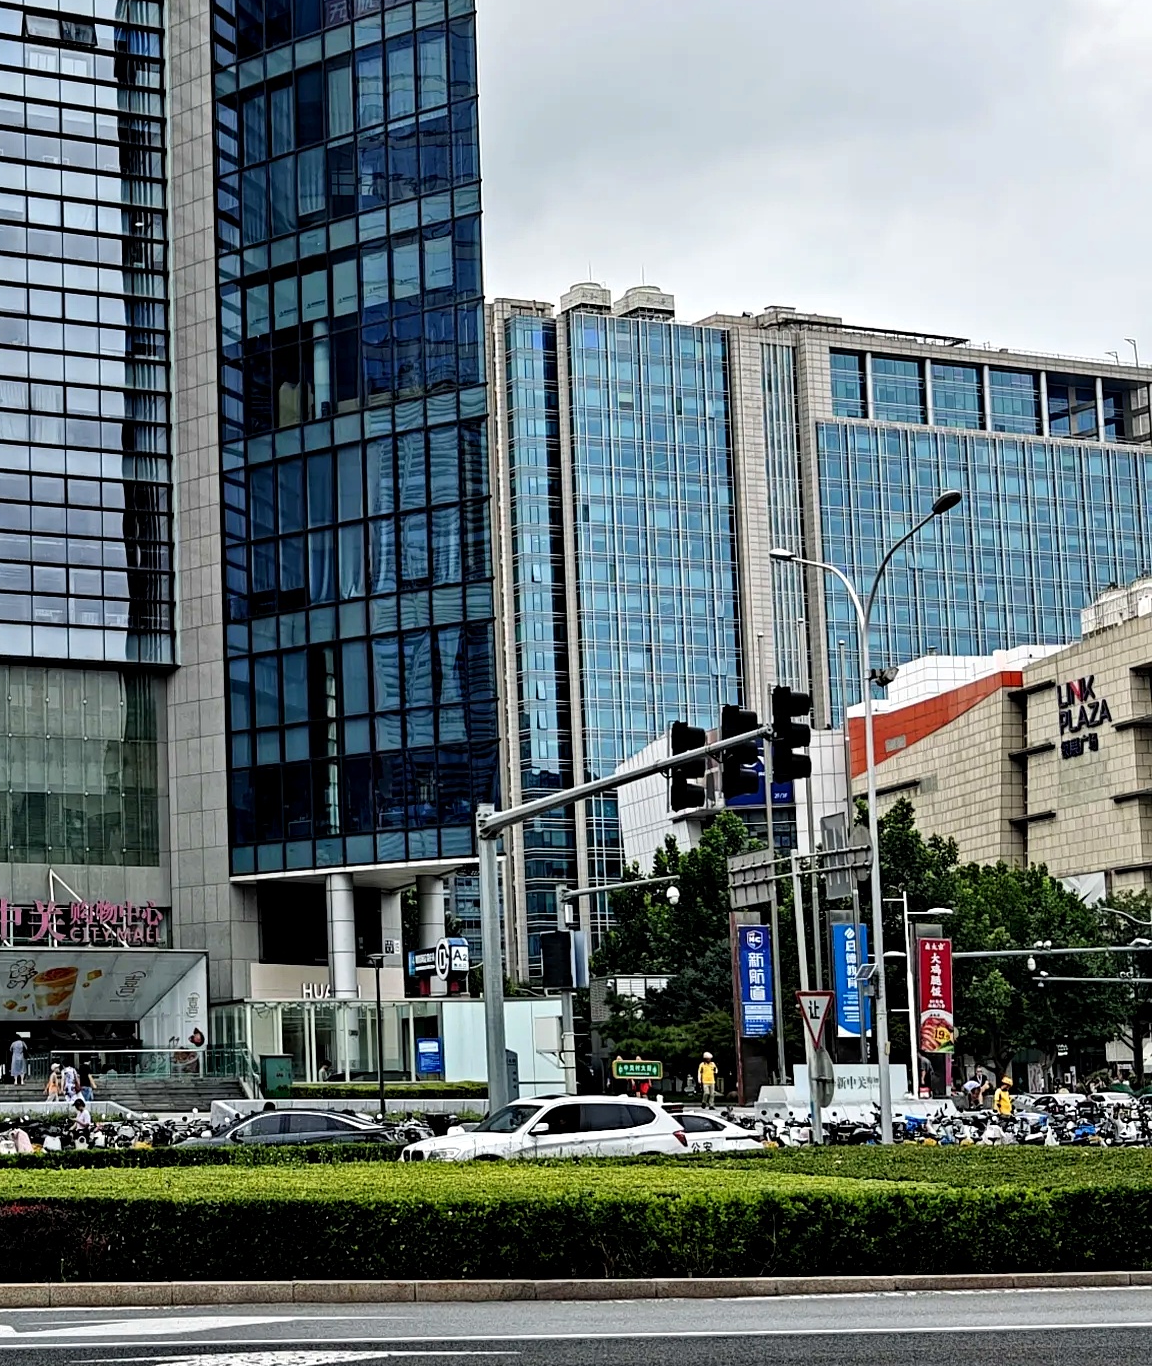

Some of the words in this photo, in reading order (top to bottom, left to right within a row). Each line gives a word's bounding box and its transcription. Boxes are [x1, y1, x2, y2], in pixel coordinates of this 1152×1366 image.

[1057, 674, 1096, 709] LINK
[1059, 699, 1112, 736] PLAZA
[70, 899, 164, 926] 购物中心
[748, 952, 766, 1001] 新航道
[808, 1000, 820, 1020] 让
[837, 1076, 867, 1089] 新中关
